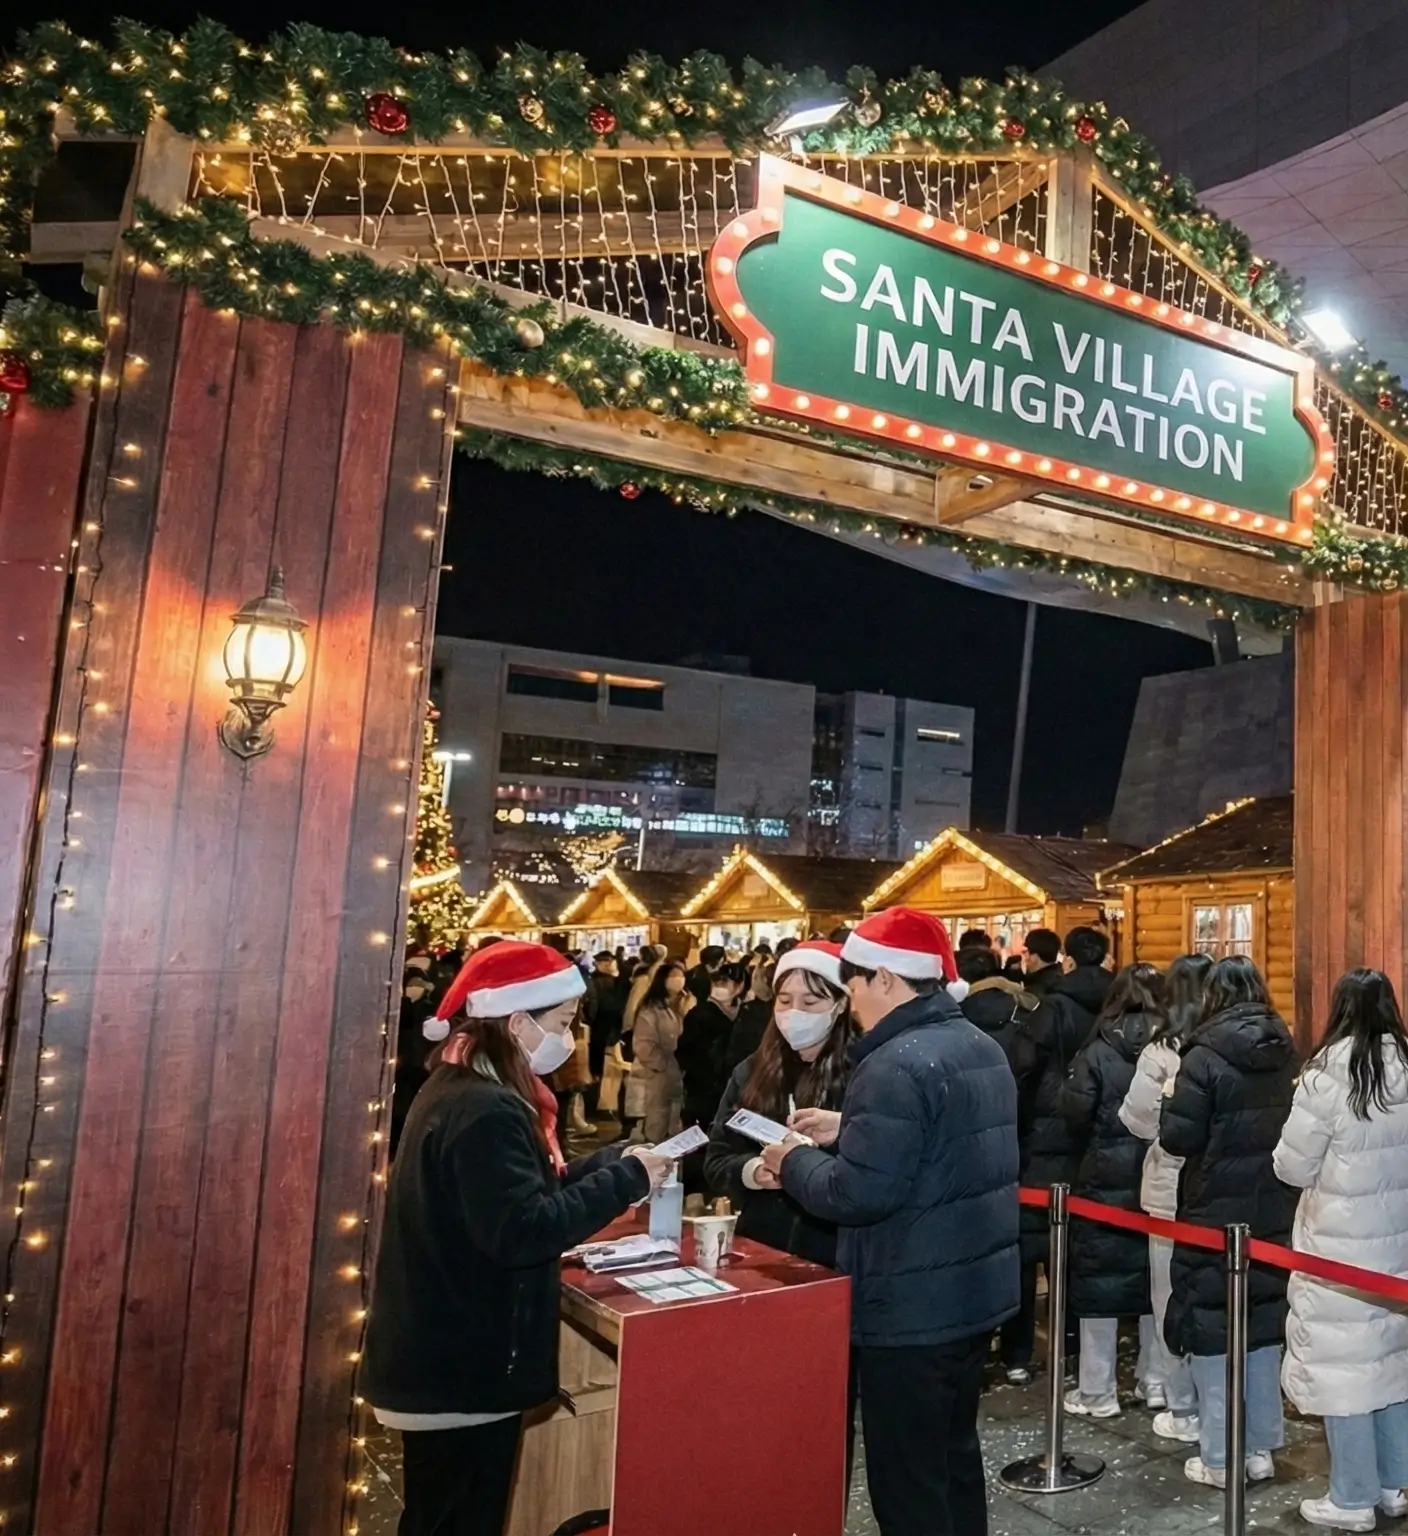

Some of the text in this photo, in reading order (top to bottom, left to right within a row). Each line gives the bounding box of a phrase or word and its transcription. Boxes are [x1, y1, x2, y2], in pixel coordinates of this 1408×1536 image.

[820, 248, 1267, 435] SANTA VILLAGE
[854, 323, 1245, 482] IMMIGRATION
